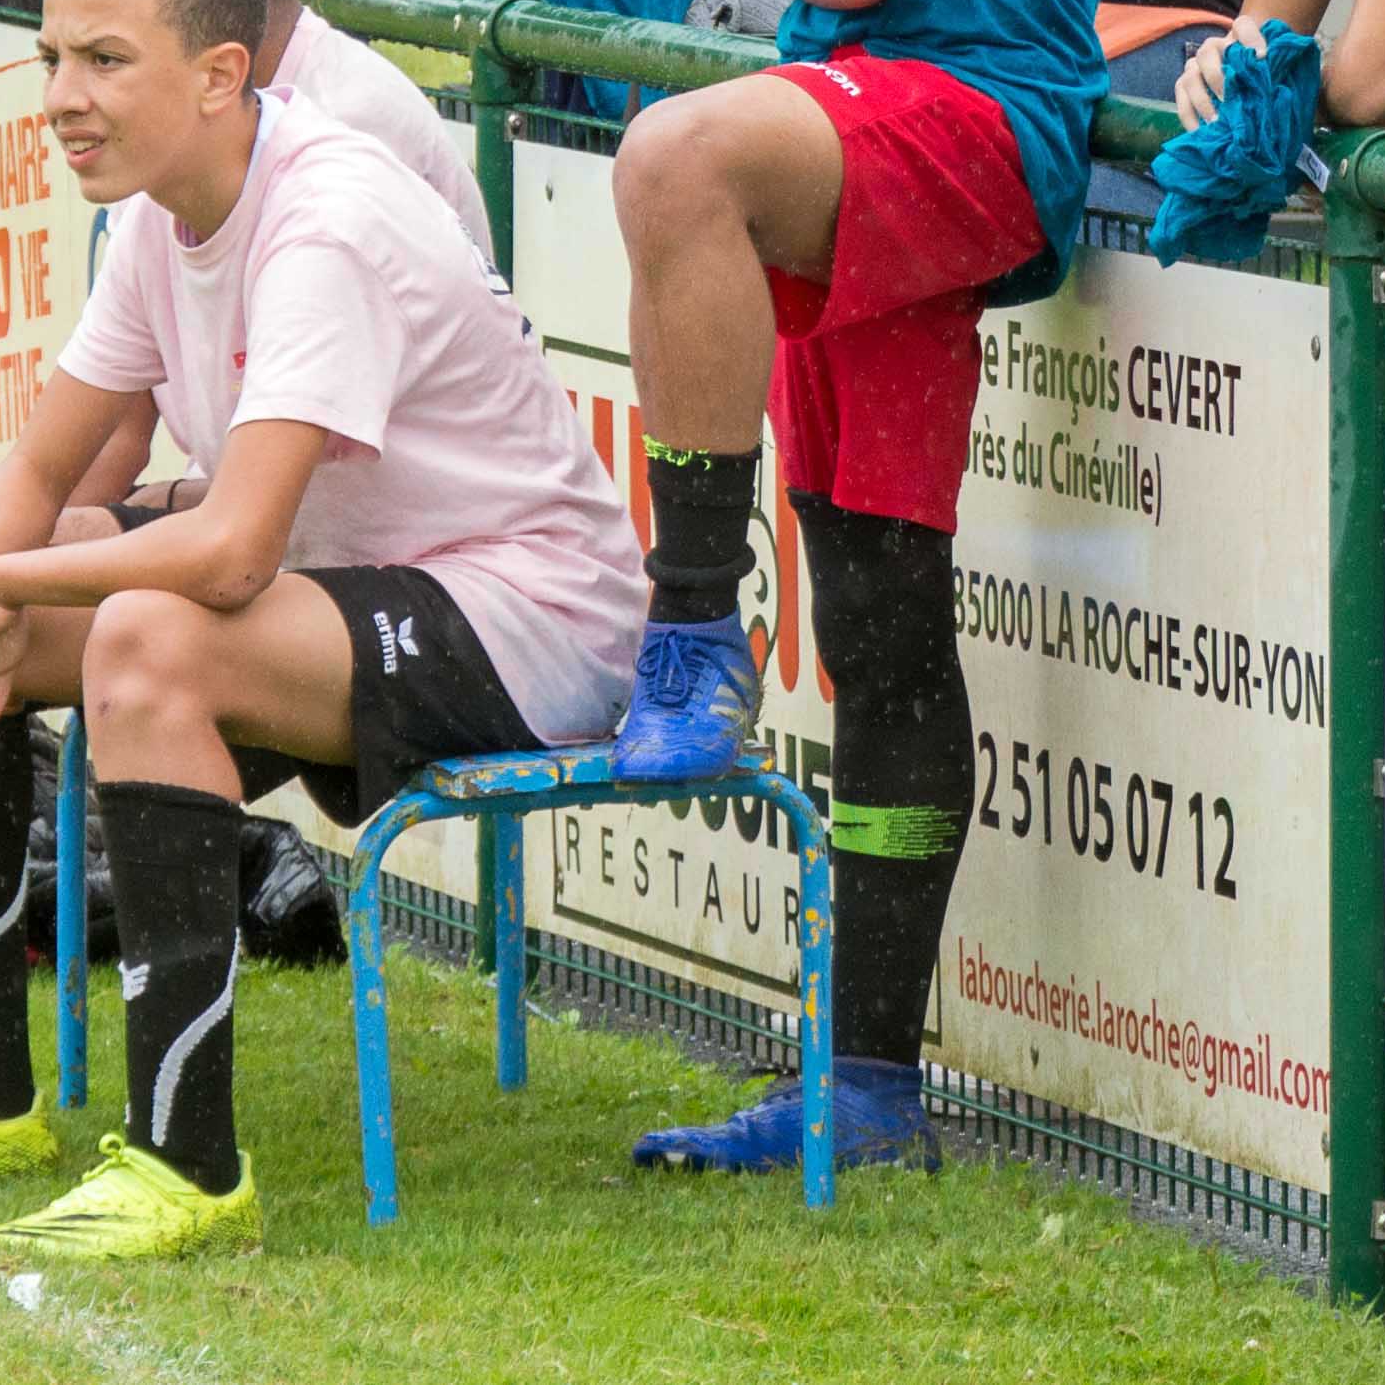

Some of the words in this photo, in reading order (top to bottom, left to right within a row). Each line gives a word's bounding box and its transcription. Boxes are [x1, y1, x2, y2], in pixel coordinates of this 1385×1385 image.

[18, 228, 52, 320] VIE
[1007, 319, 1120, 427] François
[1128, 345, 1241, 436] CEVERT
[1013, 422, 1043, 489] du
[1049, 431, 1162, 527] Cinéville)
[952, 565, 1033, 652] 85000
[1040, 585, 1076, 664] LA
[1083, 596, 1326, 729] ROCHE-SUR-YON
[1012, 740, 1052, 845] 51
[1067, 756, 1115, 863] 05
[1126, 773, 1173, 878] 07
[1188, 791, 1237, 900] 12
[957, 935, 1332, 1115] laboucherie.laroche@gmail.com
